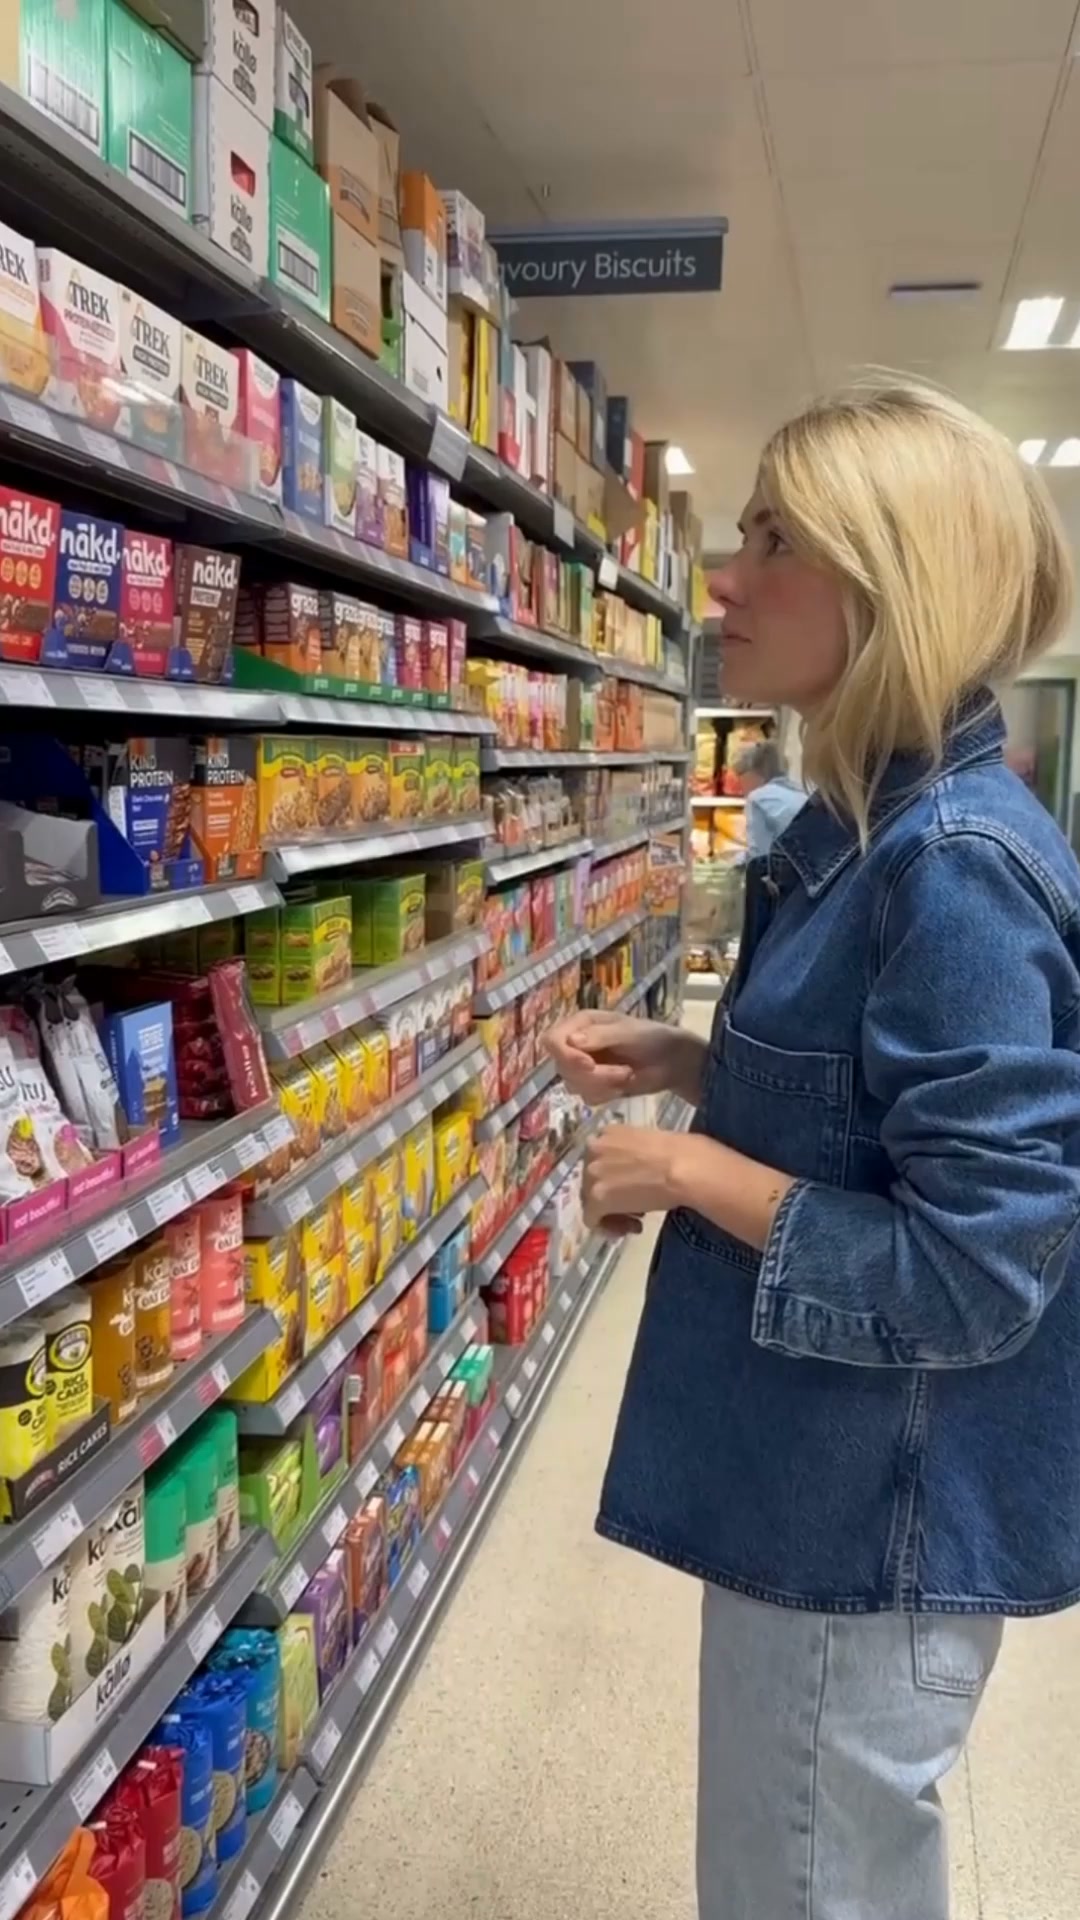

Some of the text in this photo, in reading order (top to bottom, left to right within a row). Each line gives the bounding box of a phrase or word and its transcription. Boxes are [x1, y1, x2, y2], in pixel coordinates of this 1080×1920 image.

[594, 248, 697, 279] Biscuits
[68, 280, 112, 324] TREK
[133, 315, 171, 360] TREK
[196, 354, 229, 394] TREK
[130, 770, 174, 788] PROTEIN
[207, 769, 245, 785] PROTEIN
[57, 1420, 108, 1474] RICE CAKES
